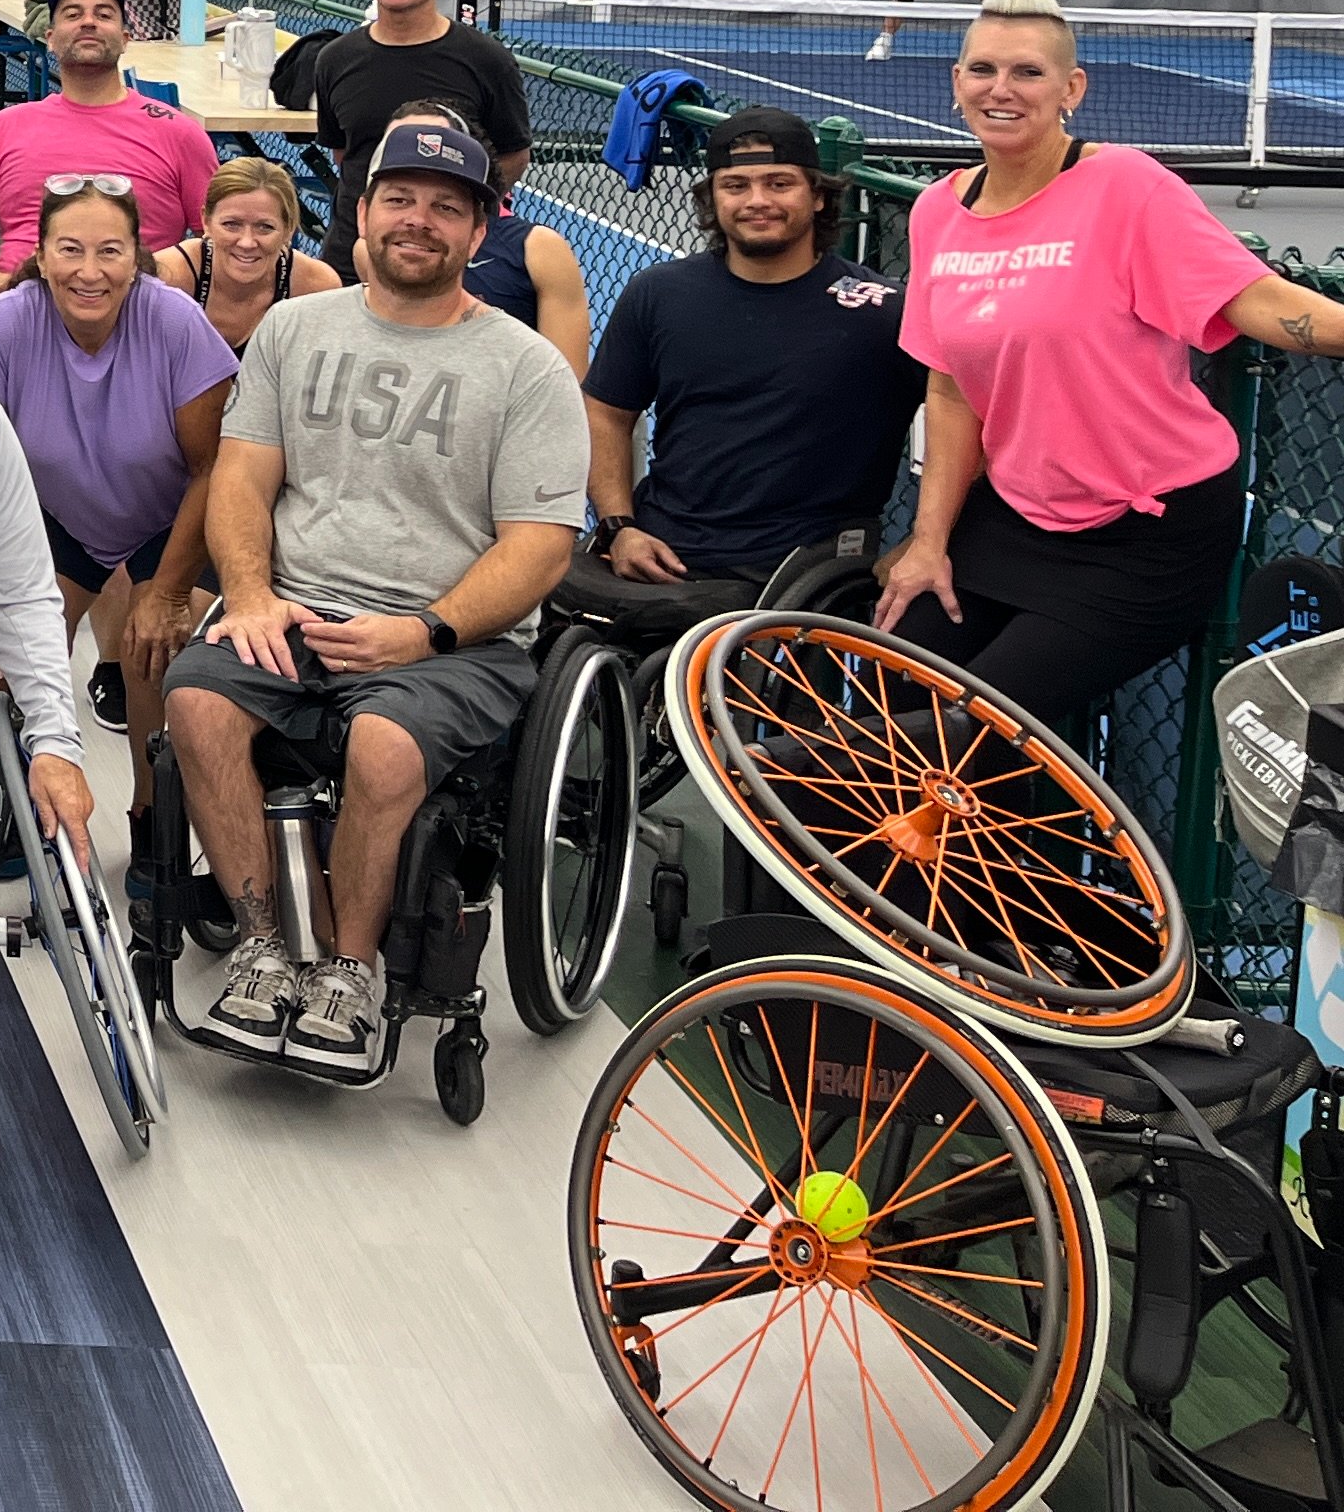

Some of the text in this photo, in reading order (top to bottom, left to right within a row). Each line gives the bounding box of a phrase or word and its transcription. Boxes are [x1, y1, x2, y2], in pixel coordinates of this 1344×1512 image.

[1008, 242, 1075, 270] STATE
[299, 350, 463, 458] USA
[1226, 730, 1293, 805] PICKLEBALL
